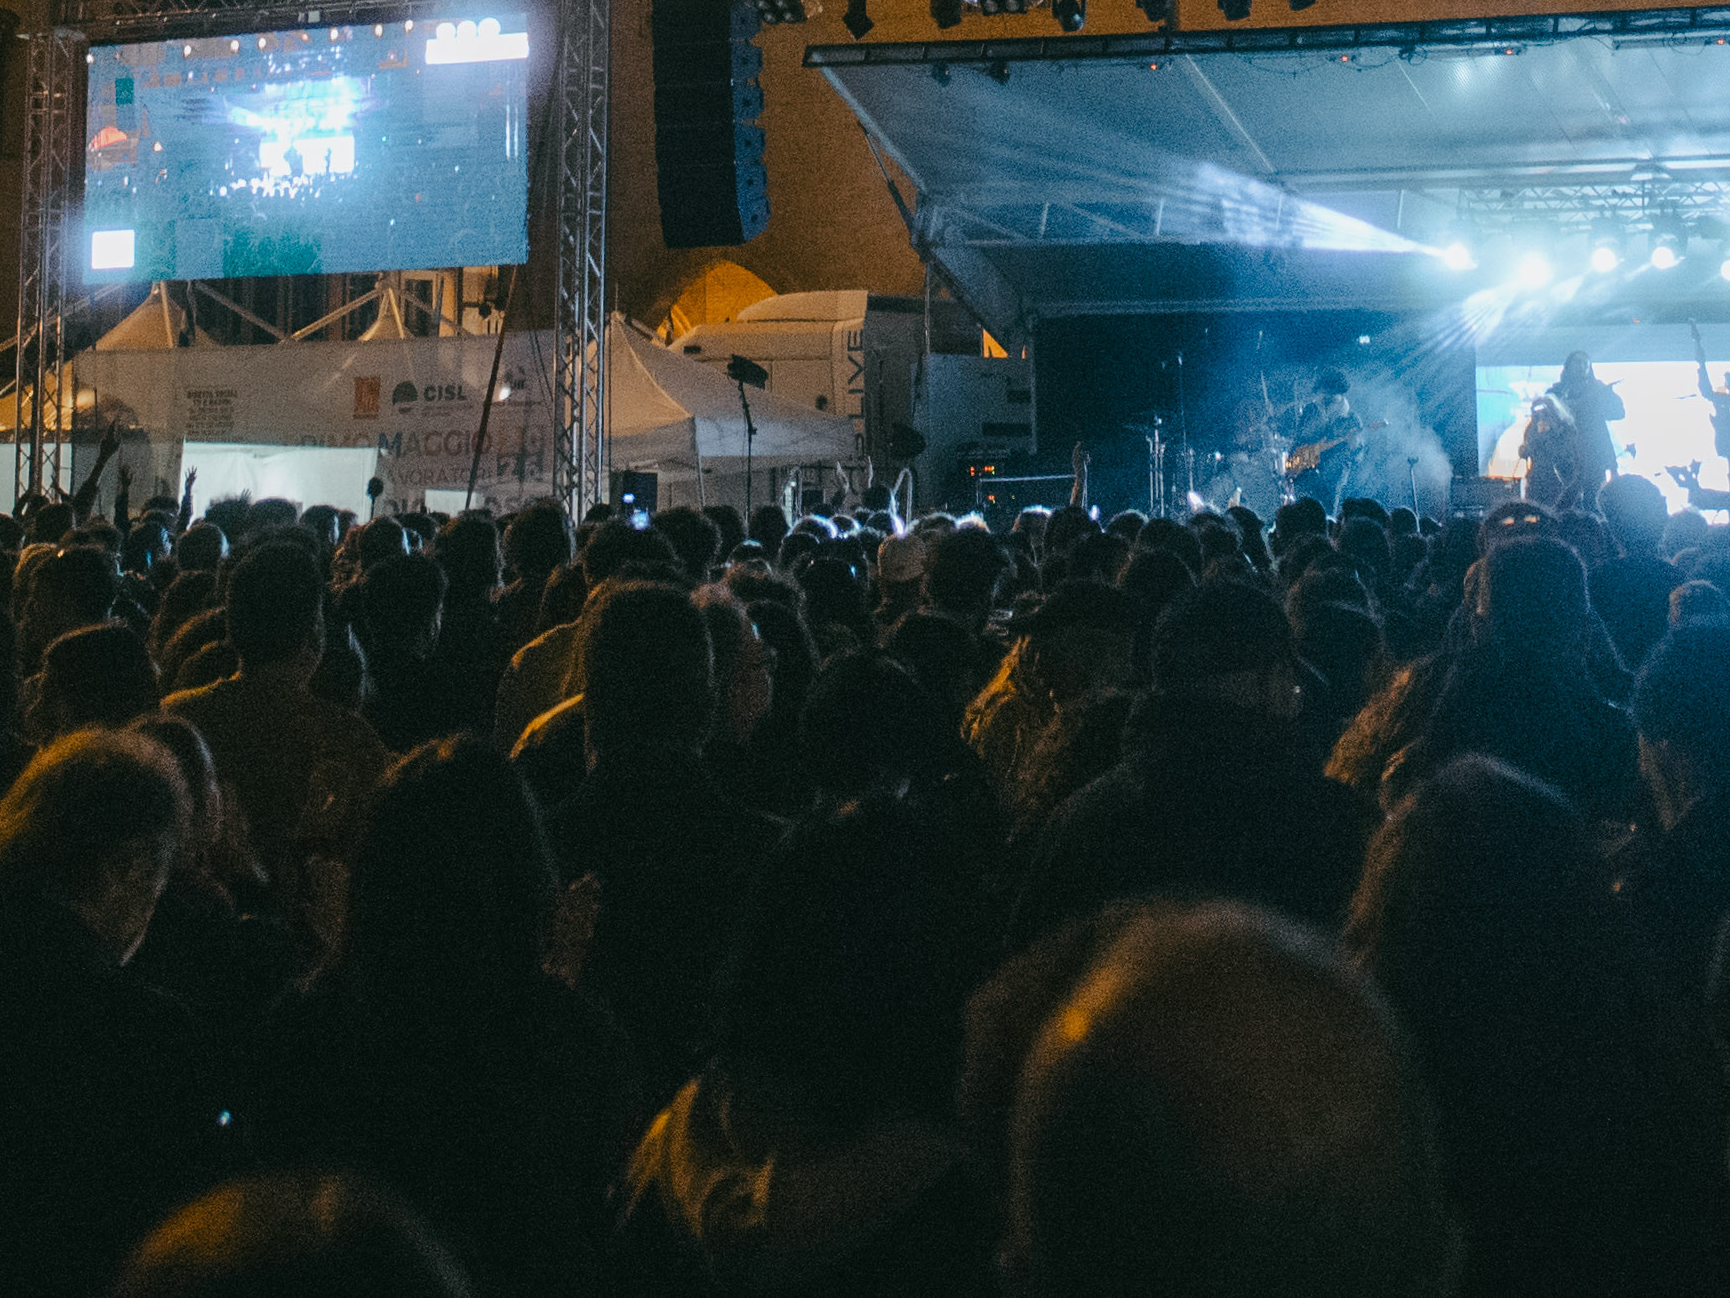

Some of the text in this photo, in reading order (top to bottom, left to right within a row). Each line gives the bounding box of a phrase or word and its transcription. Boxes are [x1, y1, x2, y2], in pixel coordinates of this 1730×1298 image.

[847, 329, 864, 418] LIVE
[423, 384, 467, 402] CISL
[377, 429, 494, 458] MAGGIO
